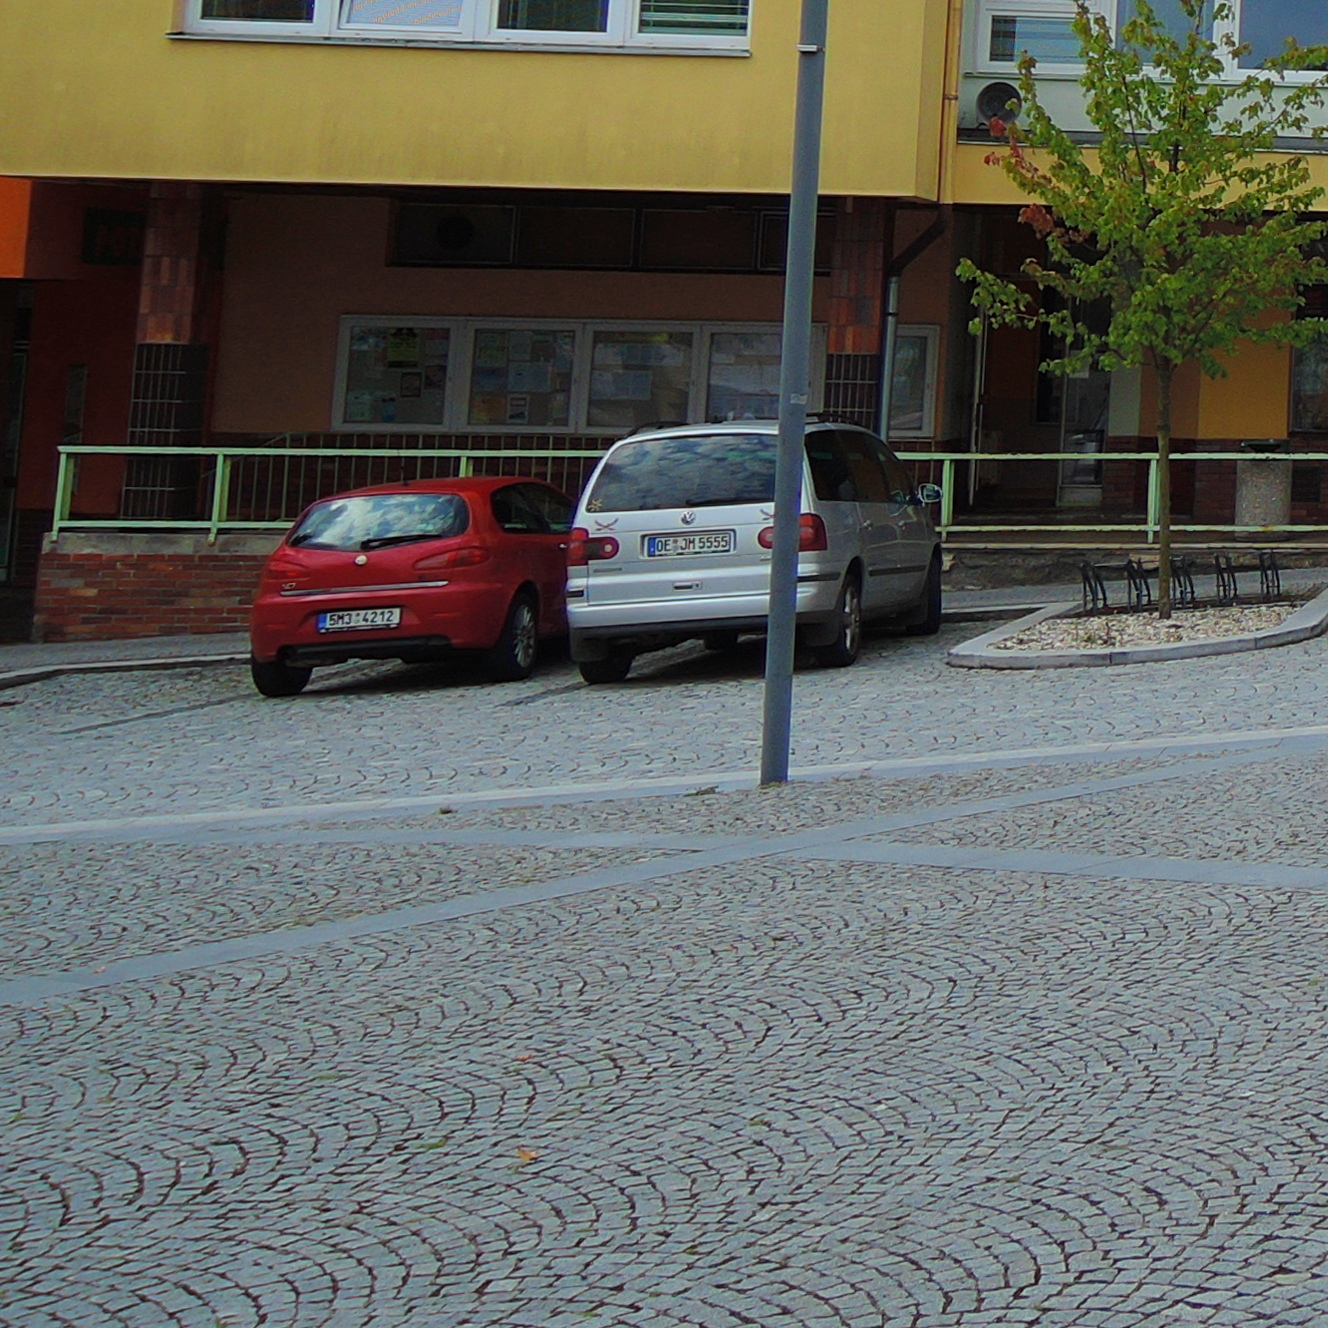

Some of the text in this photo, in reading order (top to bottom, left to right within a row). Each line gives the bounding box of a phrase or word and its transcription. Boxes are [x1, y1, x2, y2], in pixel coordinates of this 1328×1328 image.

[656, 539, 671, 552] OE
[699, 535, 728, 548] 5555
[329, 610, 394, 626] 5M3 4212
